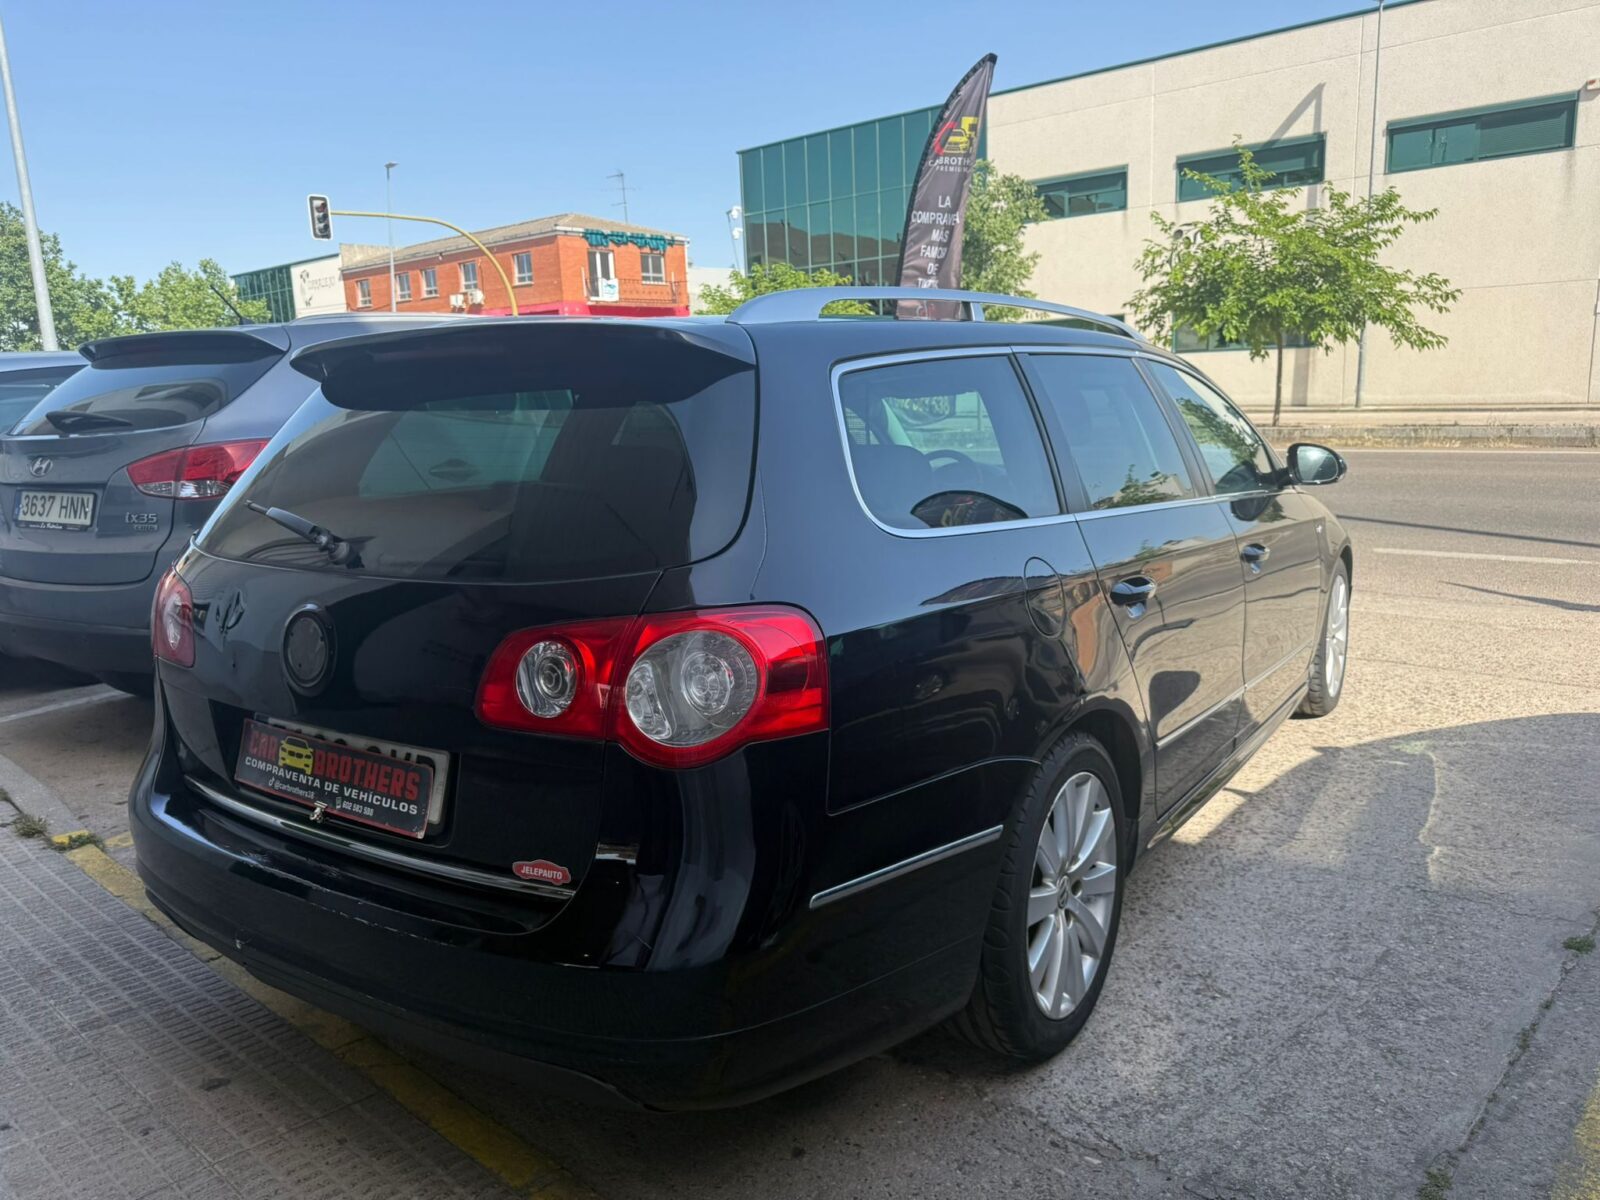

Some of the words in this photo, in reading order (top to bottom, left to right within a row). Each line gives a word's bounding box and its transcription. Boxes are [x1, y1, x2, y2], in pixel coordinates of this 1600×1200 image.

[938, 196, 952, 208] LA
[22, 495, 55, 517] 3637
[58, 497, 90, 520] HNN
[248, 731, 279, 762] CAR
[313, 749, 421, 801] BROTHERS
[245, 756, 321, 788] COMPRAVENTA
[324, 781, 340, 794] DE
[343, 786, 418, 815] VEHÍCULOS
[521, 865, 562, 879] JELEPAUTO
